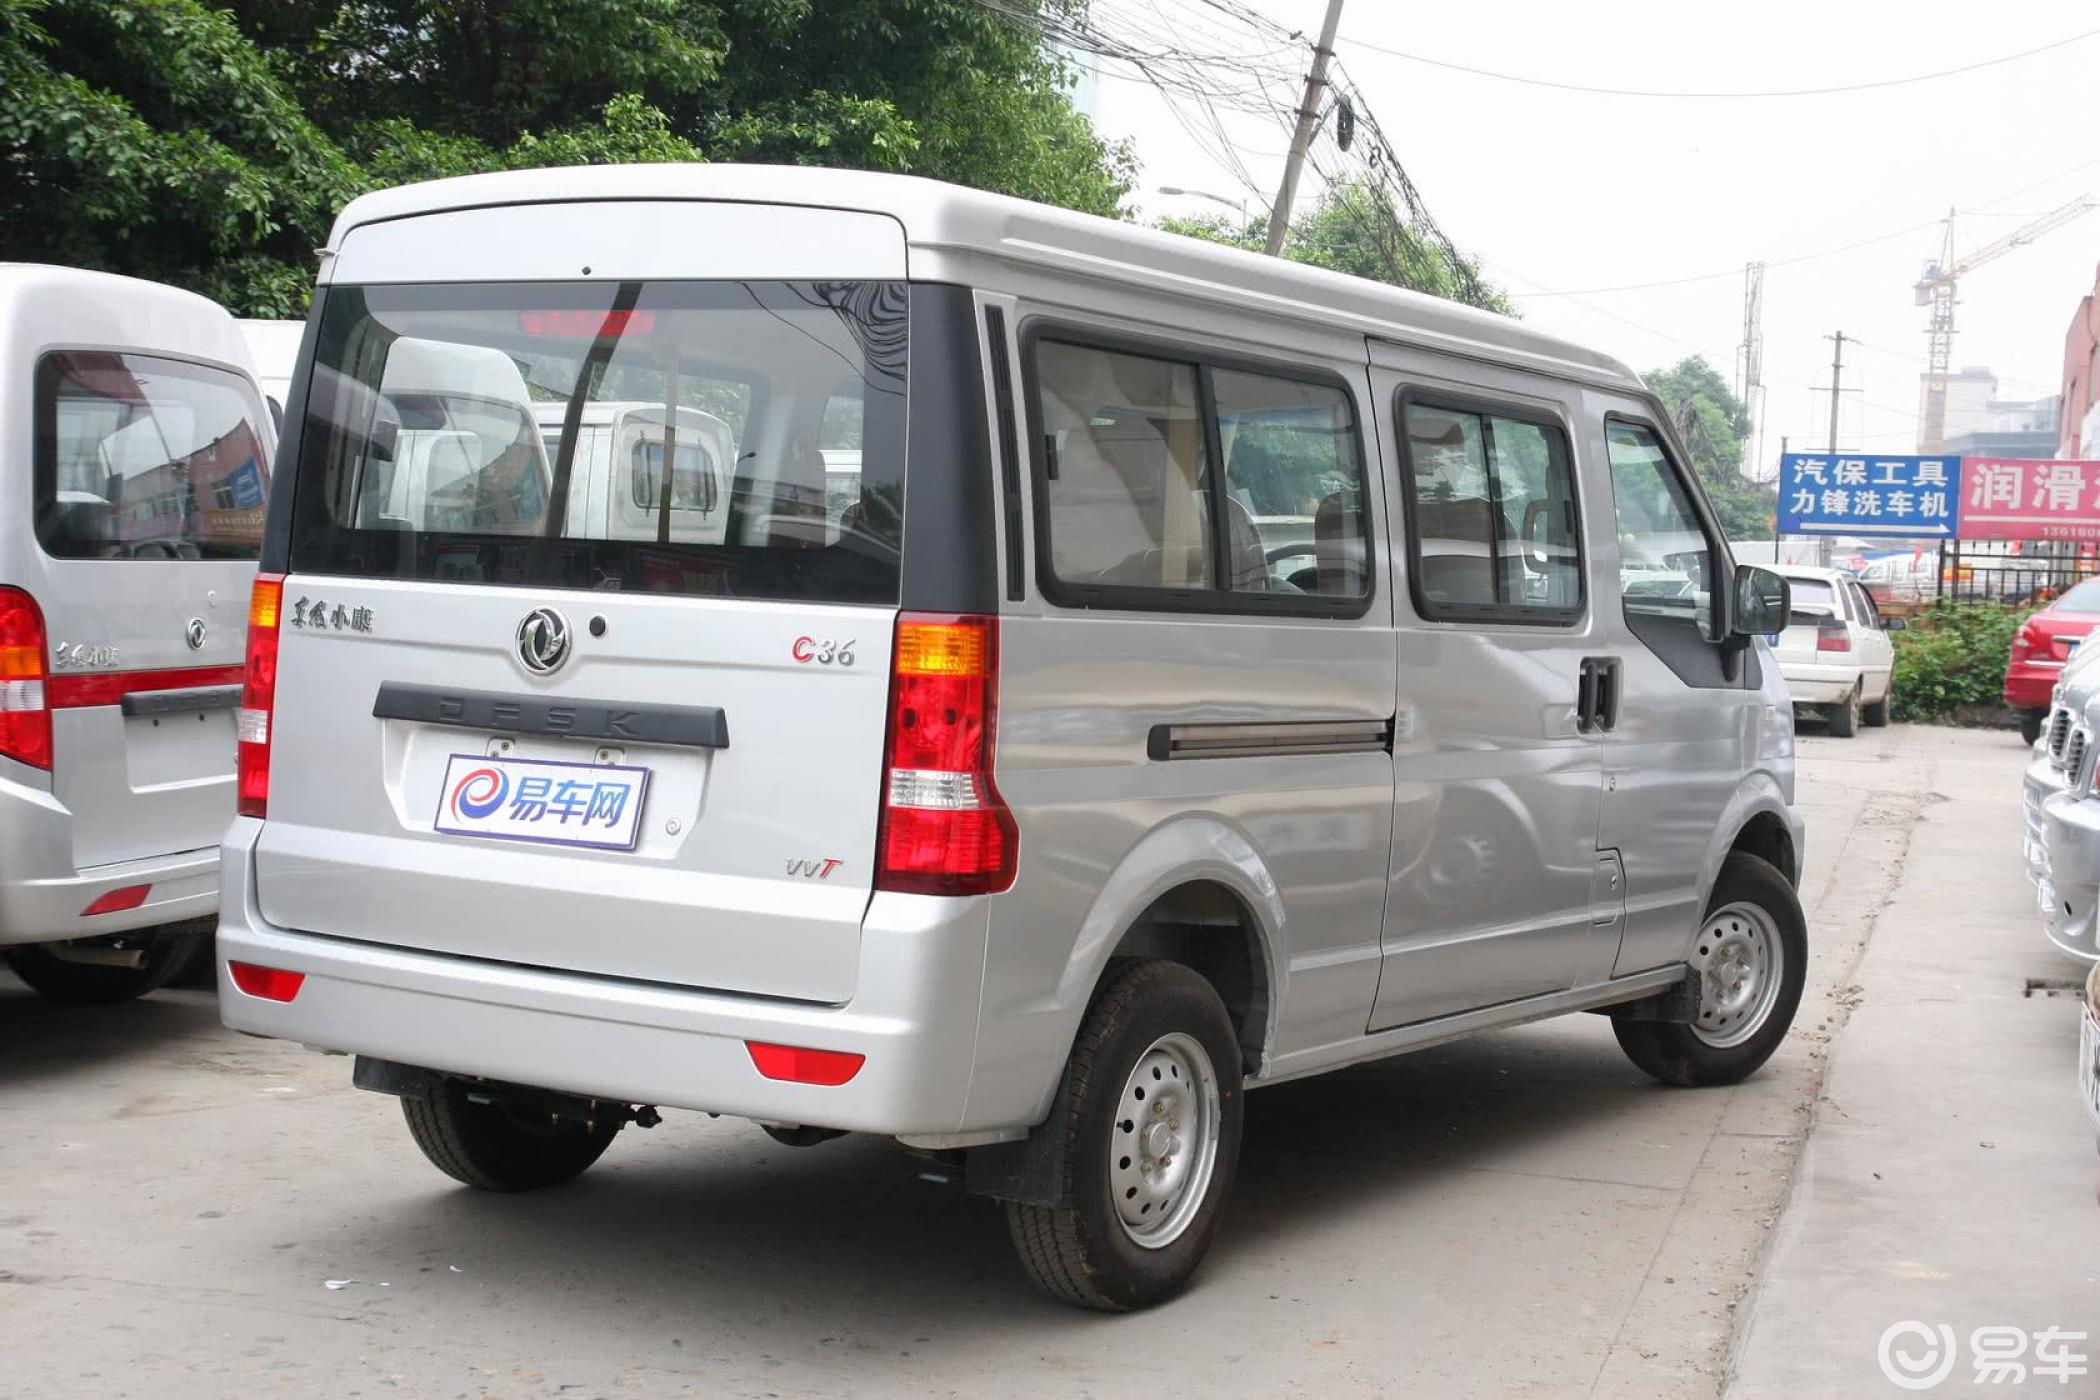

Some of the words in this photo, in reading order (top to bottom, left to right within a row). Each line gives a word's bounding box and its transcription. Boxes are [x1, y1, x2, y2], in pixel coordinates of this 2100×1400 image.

[1793, 459, 1949, 487] 汽保工具
[1970, 463, 2100, 512] 润滑
[1789, 489, 1949, 518] 力锋洗车机
[792, 635, 857, 667] C36
[440, 697, 640, 737] DFSK
[509, 776, 631, 829] 易车网
[786, 857, 844, 880] VVT
